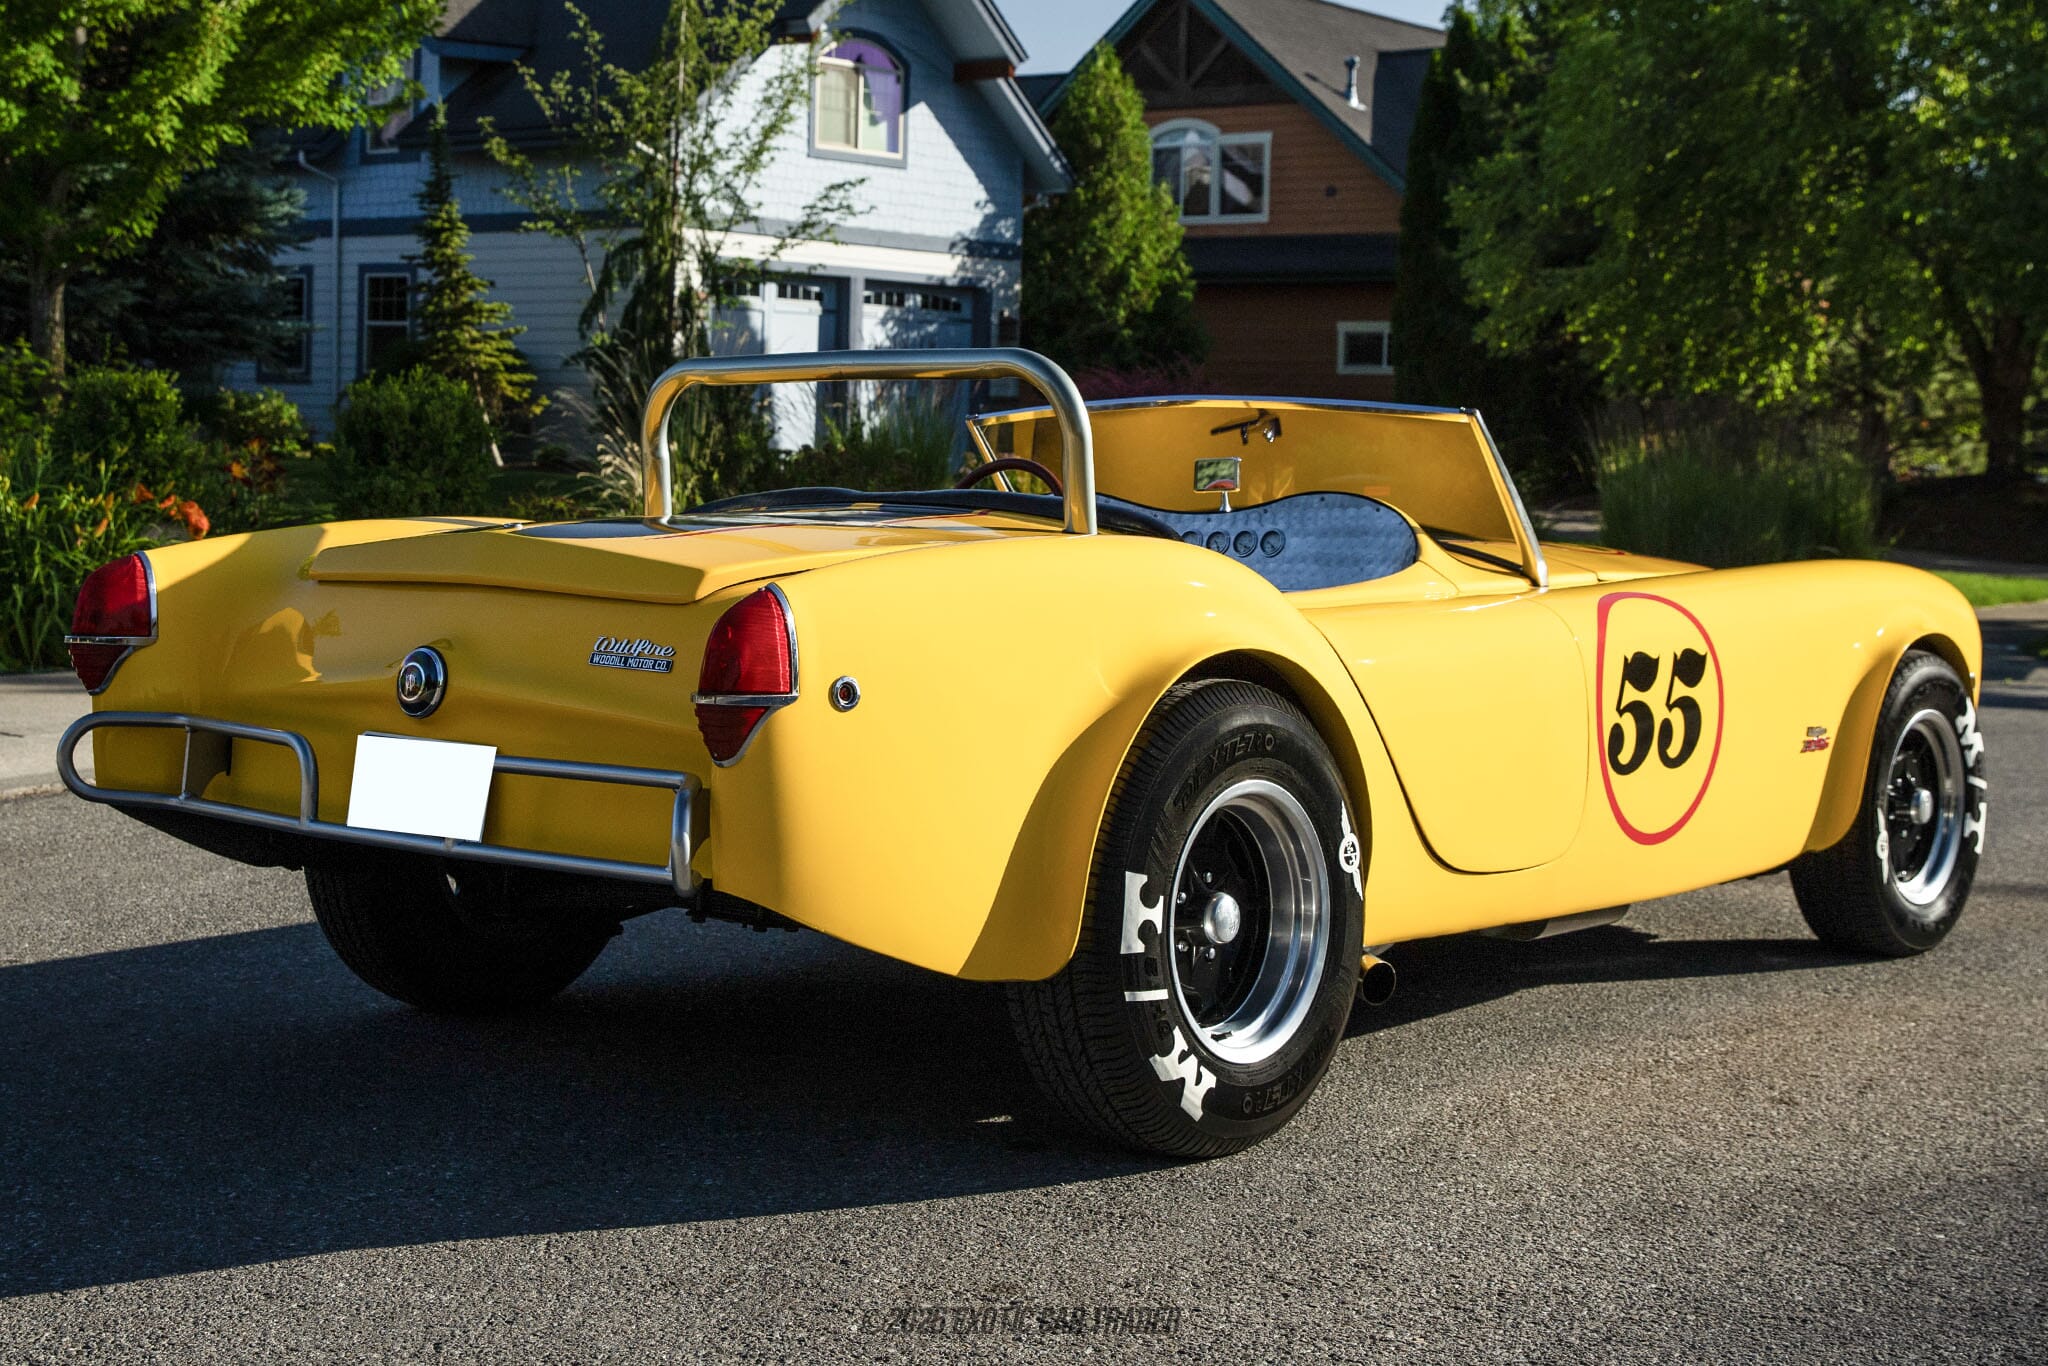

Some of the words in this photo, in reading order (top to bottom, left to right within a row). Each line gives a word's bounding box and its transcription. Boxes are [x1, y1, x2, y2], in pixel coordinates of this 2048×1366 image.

[594, 636, 676, 657] Wildfire
[593, 654, 625, 667] WOODILL
[627, 659, 653, 670] MOTOR
[655, 660, 668, 671] CO.
[1608, 648, 1707, 776] 55
